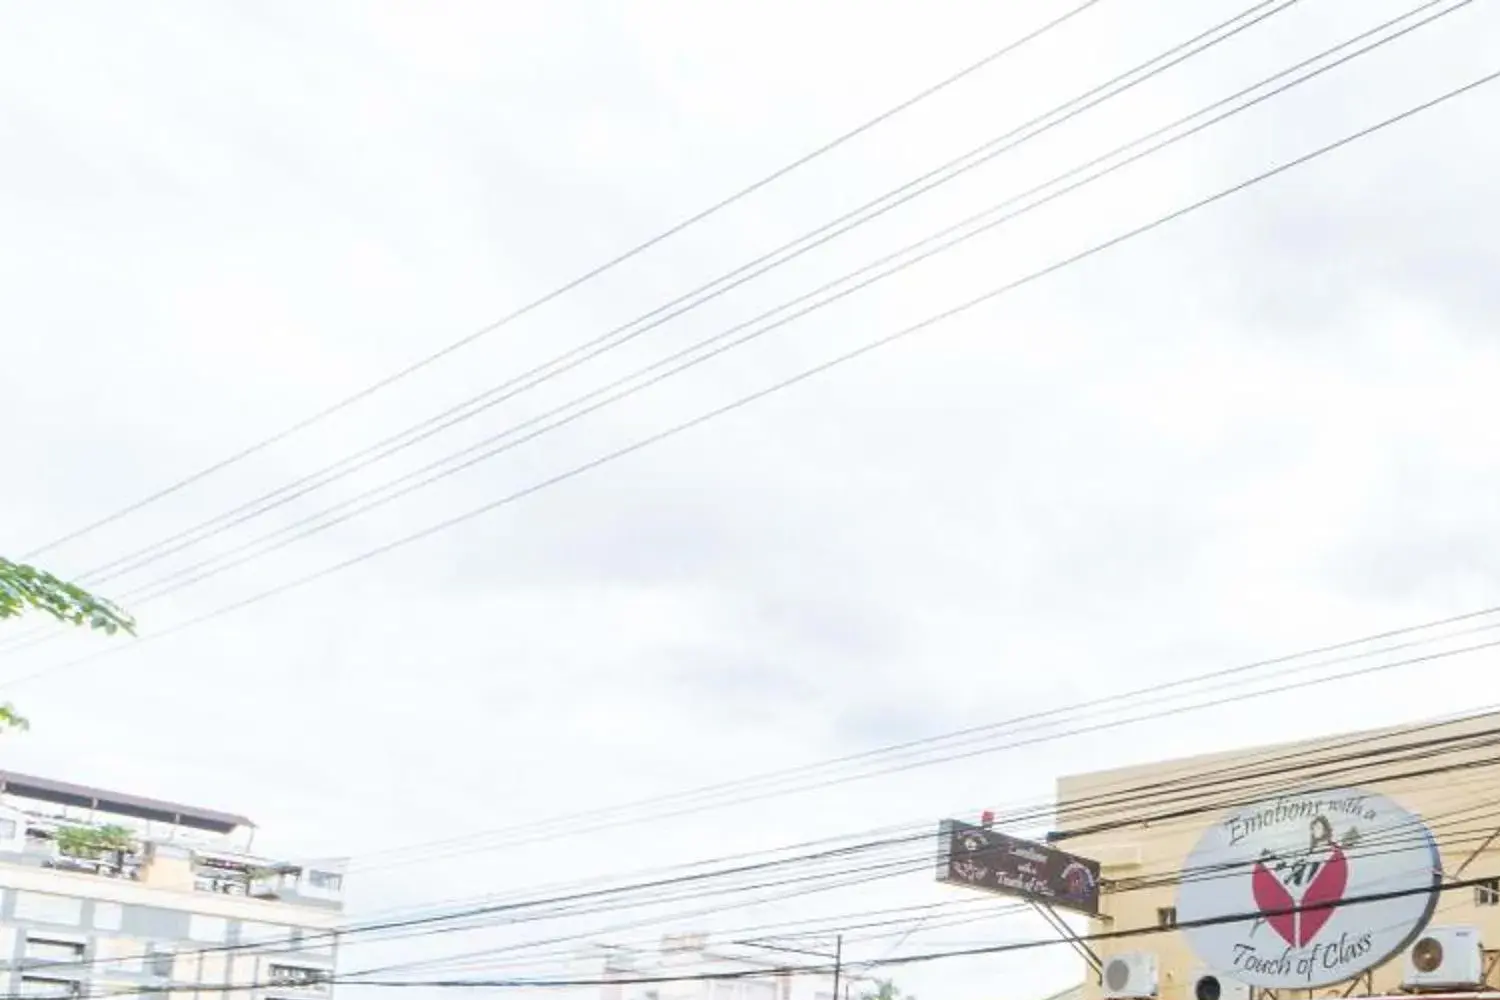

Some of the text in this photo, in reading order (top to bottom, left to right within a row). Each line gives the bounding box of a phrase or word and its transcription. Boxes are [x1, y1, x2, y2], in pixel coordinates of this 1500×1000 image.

[1225, 797, 1376, 846] Emotions with a
[1231, 931, 1374, 981] Touch of Class
